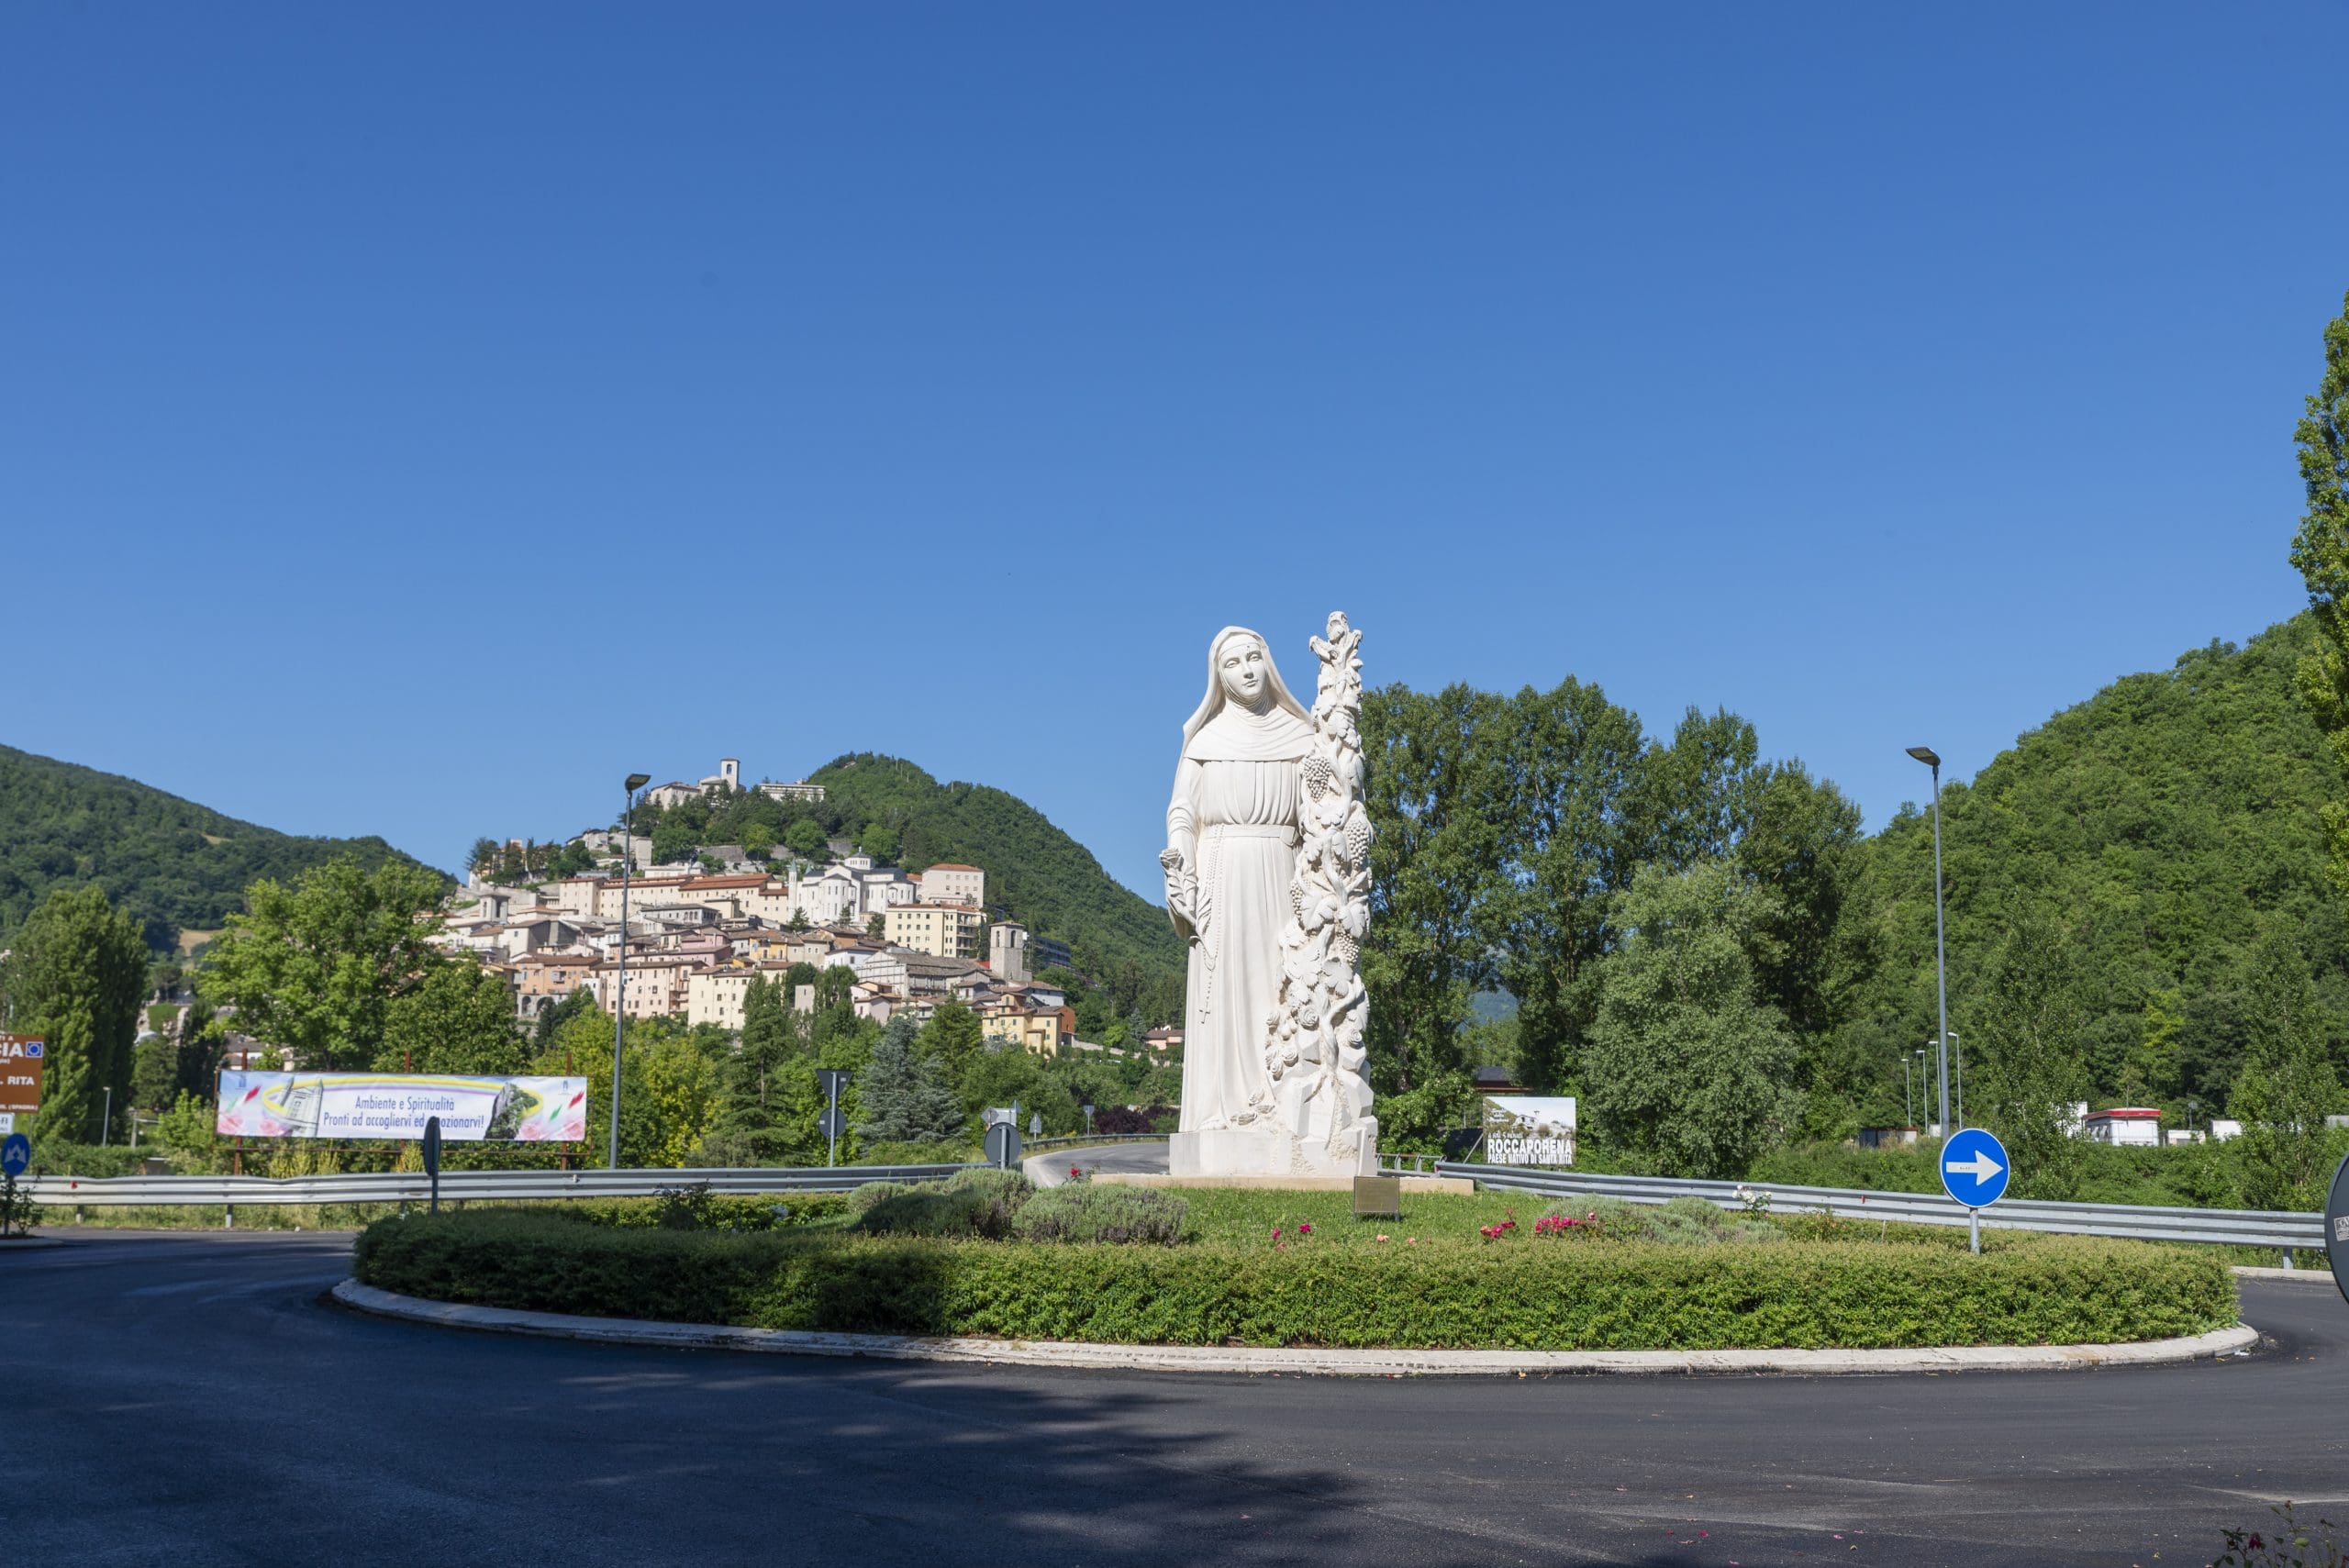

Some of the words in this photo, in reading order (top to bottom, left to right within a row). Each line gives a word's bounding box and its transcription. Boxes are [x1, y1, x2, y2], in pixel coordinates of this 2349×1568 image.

[7, 1076, 35, 1085] RITA
[355, 1095, 396, 1110] Ambiente
[399, 1100, 404, 1110] e
[407, 1095, 454, 1114] Spiritualità
[324, 1113, 350, 1126] Pronti
[352, 1113, 362, 1127] ad
[366, 1113, 412, 1129] accogliervi
[414, 1113, 425, 1127] ed
[439, 1115, 484, 1129] ozionarvi!
[1487, 1139, 1572, 1154] ROCCAPORENA
[1488, 1153, 1507, 1164] PAESE
[1508, 1153, 1529, 1164] NATIVO
[1531, 1153, 1537, 1164] DI
[1538, 1153, 1557, 1164] SANTA
[1558, 1153, 1573, 1165] RITA
